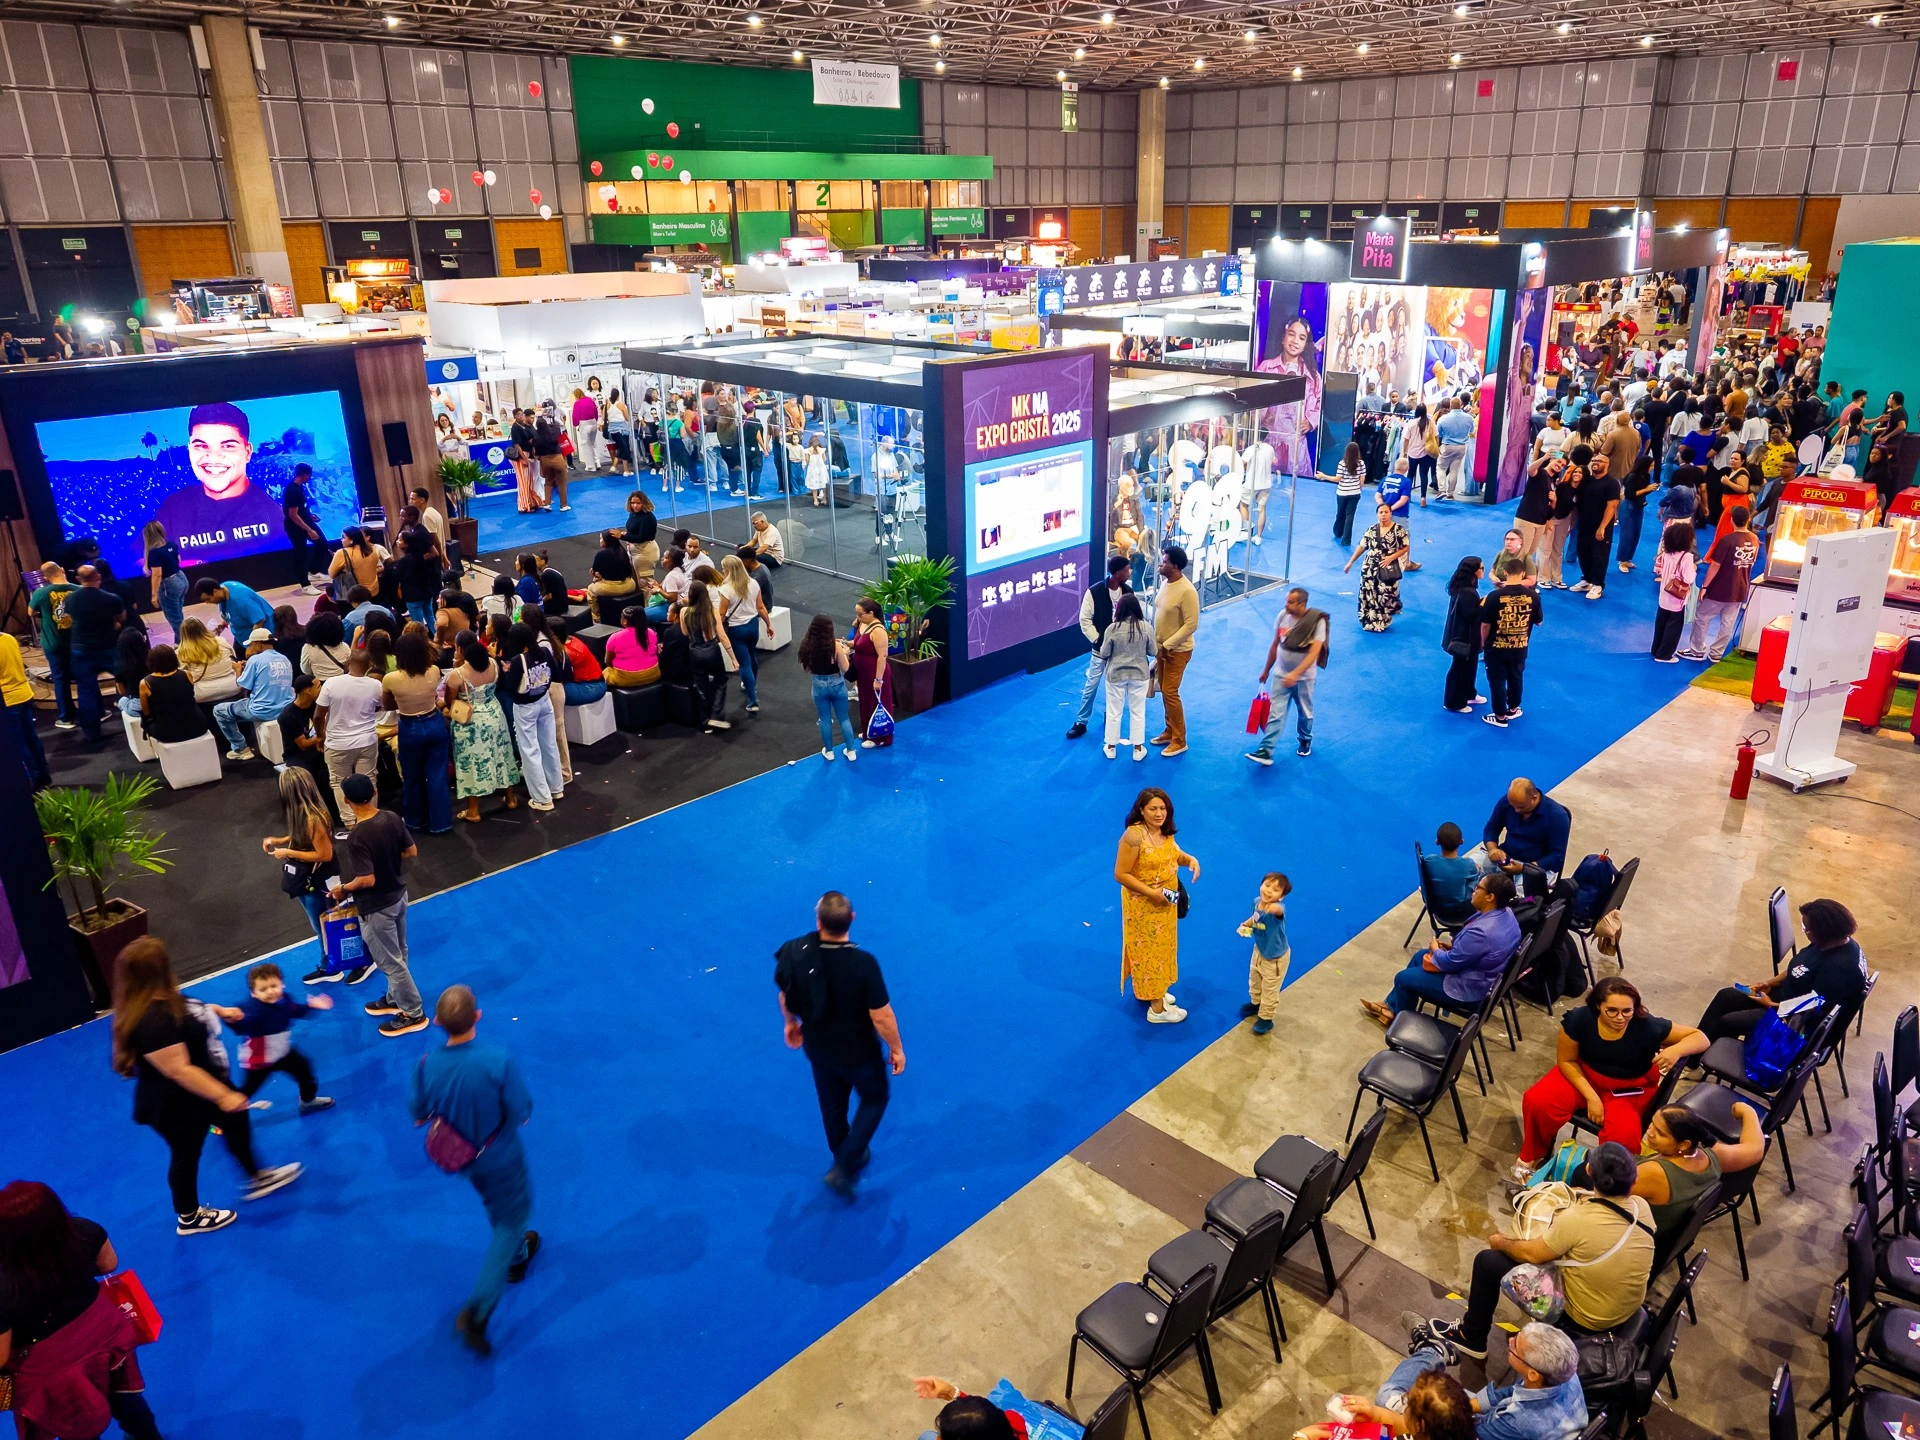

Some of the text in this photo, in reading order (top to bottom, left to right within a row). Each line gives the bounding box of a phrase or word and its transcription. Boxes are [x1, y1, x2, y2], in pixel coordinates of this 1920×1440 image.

[820, 66, 851, 76] Banheiros
[858, 70, 890, 79] Bebedouro
[816, 183, 829, 206] 2
[678, 221, 706, 229] Masculino
[1640, 224, 1651, 239] Maria
[1366, 231, 1394, 246] Maria
[1362, 246, 1393, 268] Pita
[1638, 240, 1650, 259] Pita
[1011, 391, 1049, 418] MK NA
[976, 409, 1081, 450] EXPO CRISTÃ 2025
[1803, 489, 1845, 501] PIPOCA
[179, 523, 269, 549] PAULO NETO
[1192, 539, 1229, 584] FM
